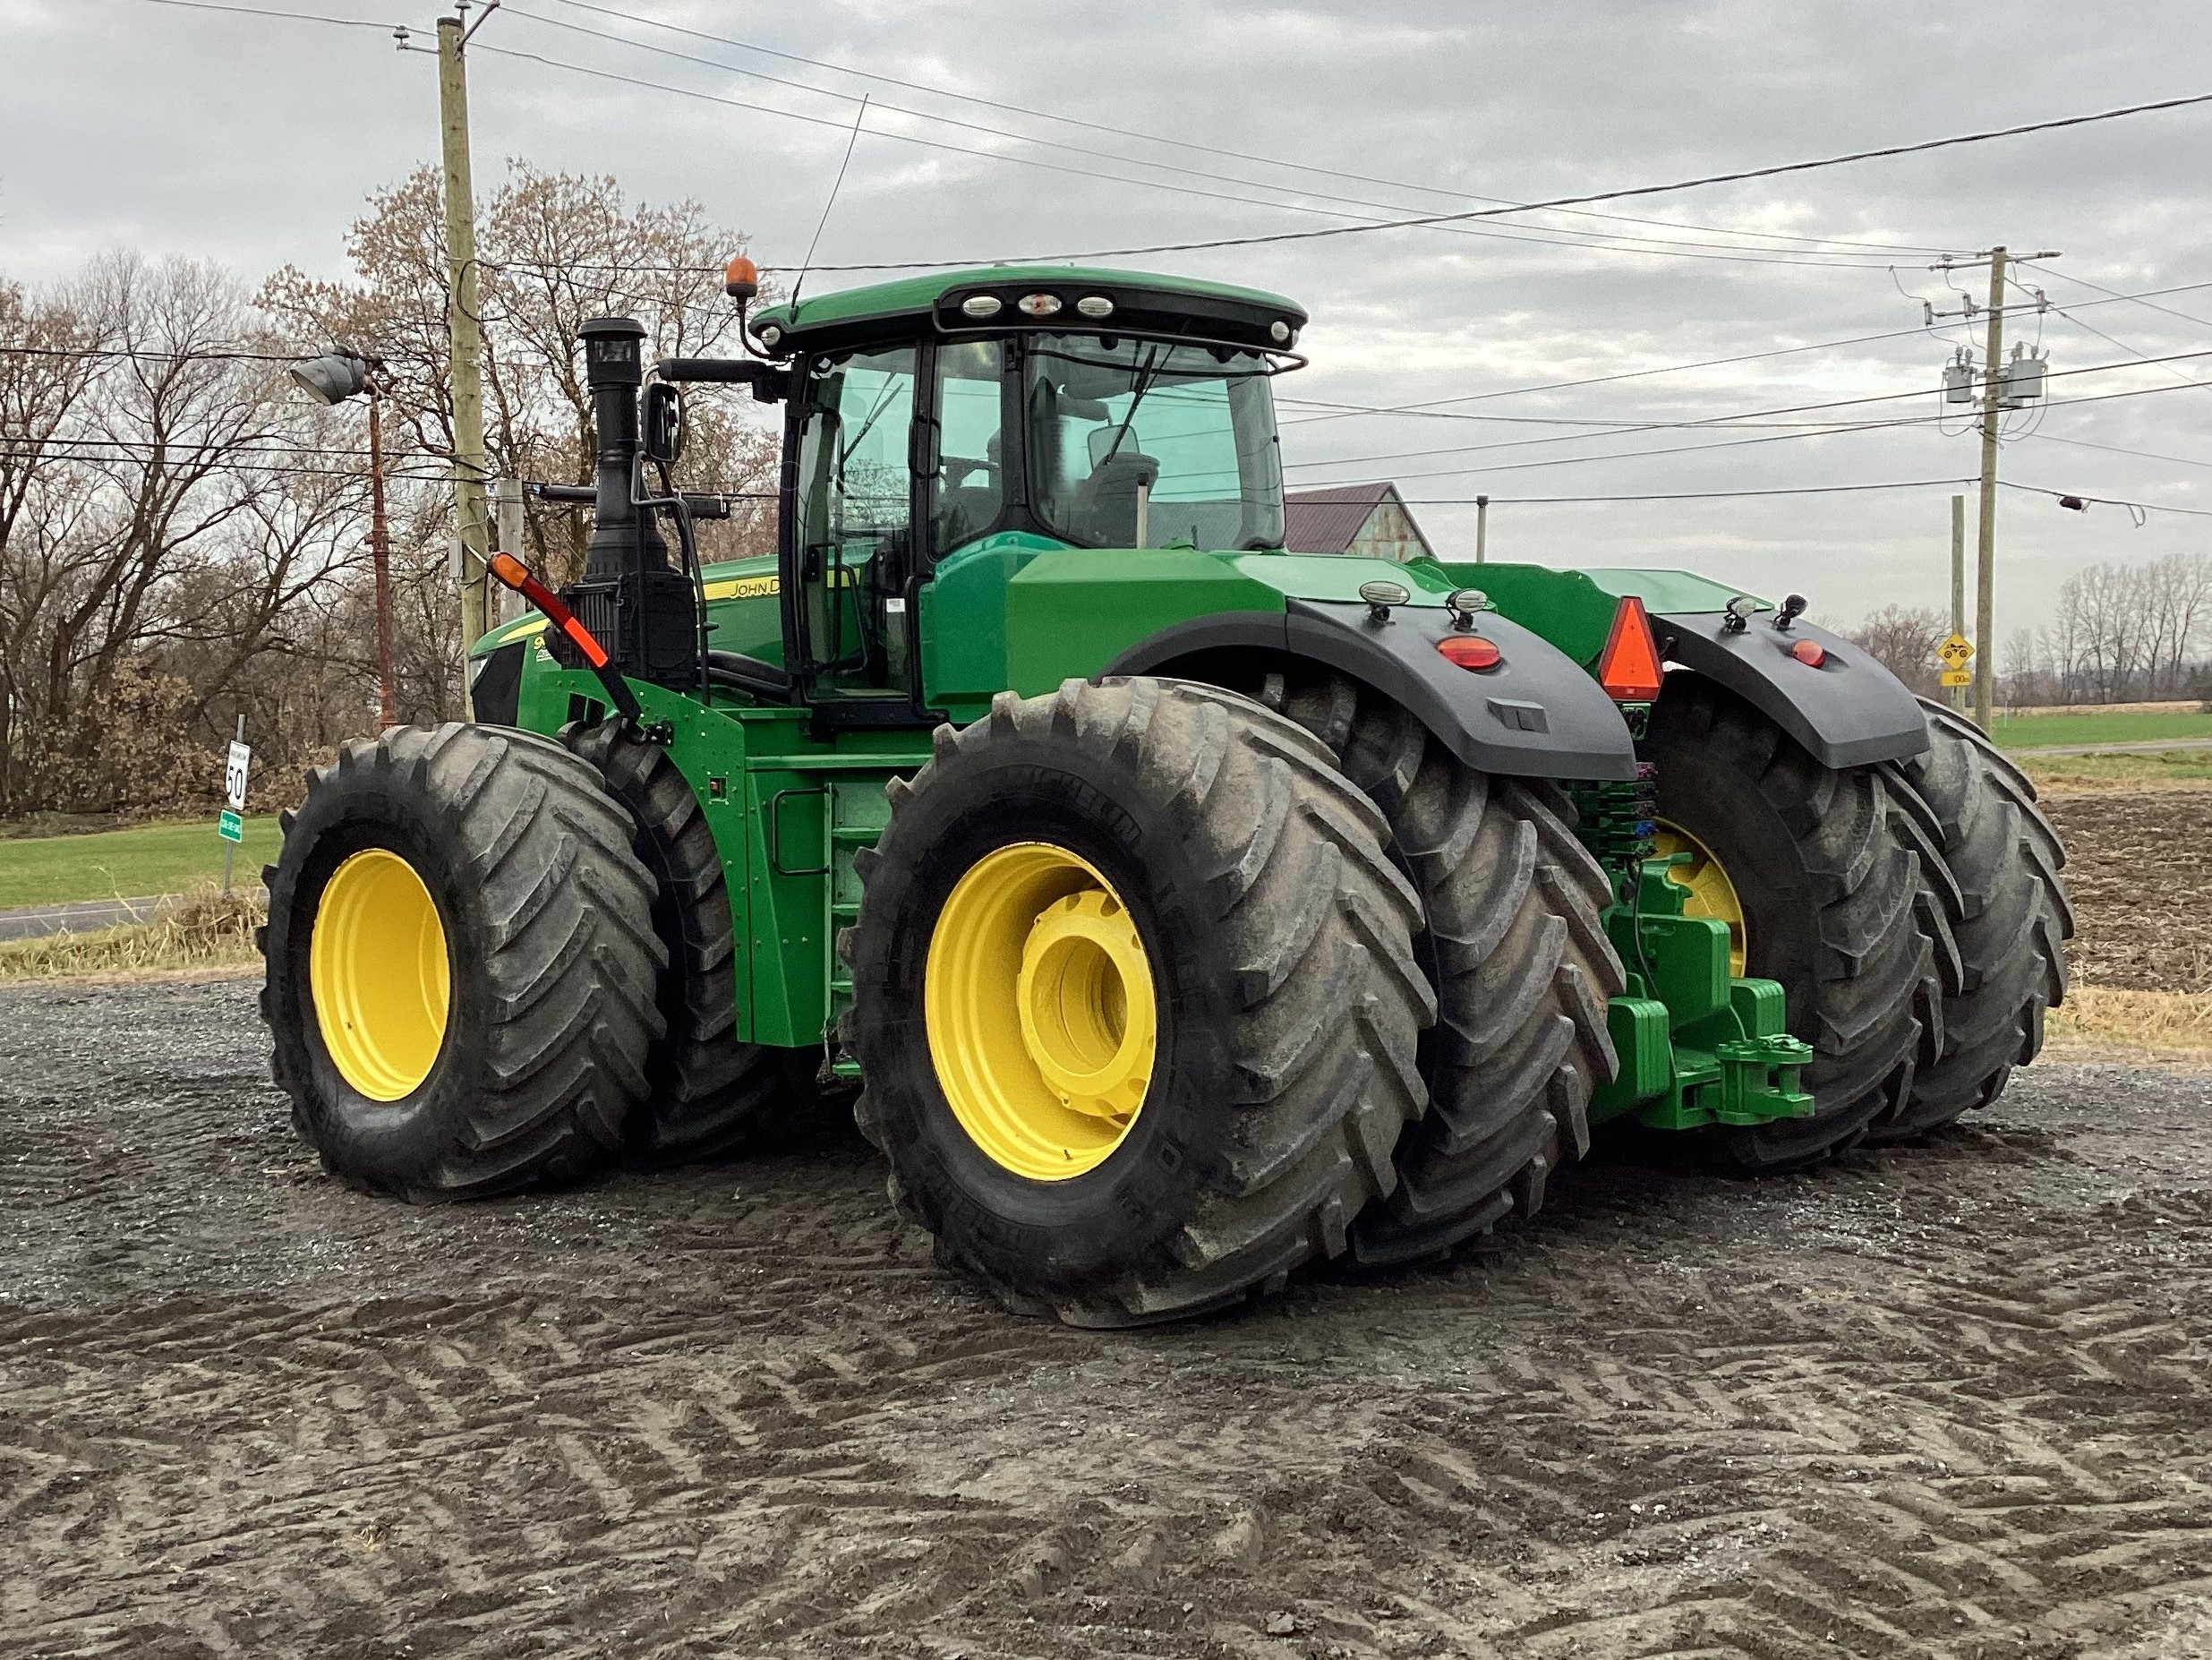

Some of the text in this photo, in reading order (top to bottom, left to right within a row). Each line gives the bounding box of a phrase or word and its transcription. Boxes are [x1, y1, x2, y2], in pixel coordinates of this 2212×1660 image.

[730, 582, 767, 596] JOHN
[227, 766, 243, 800] 50
[1006, 766, 1141, 844] MICHELIN
